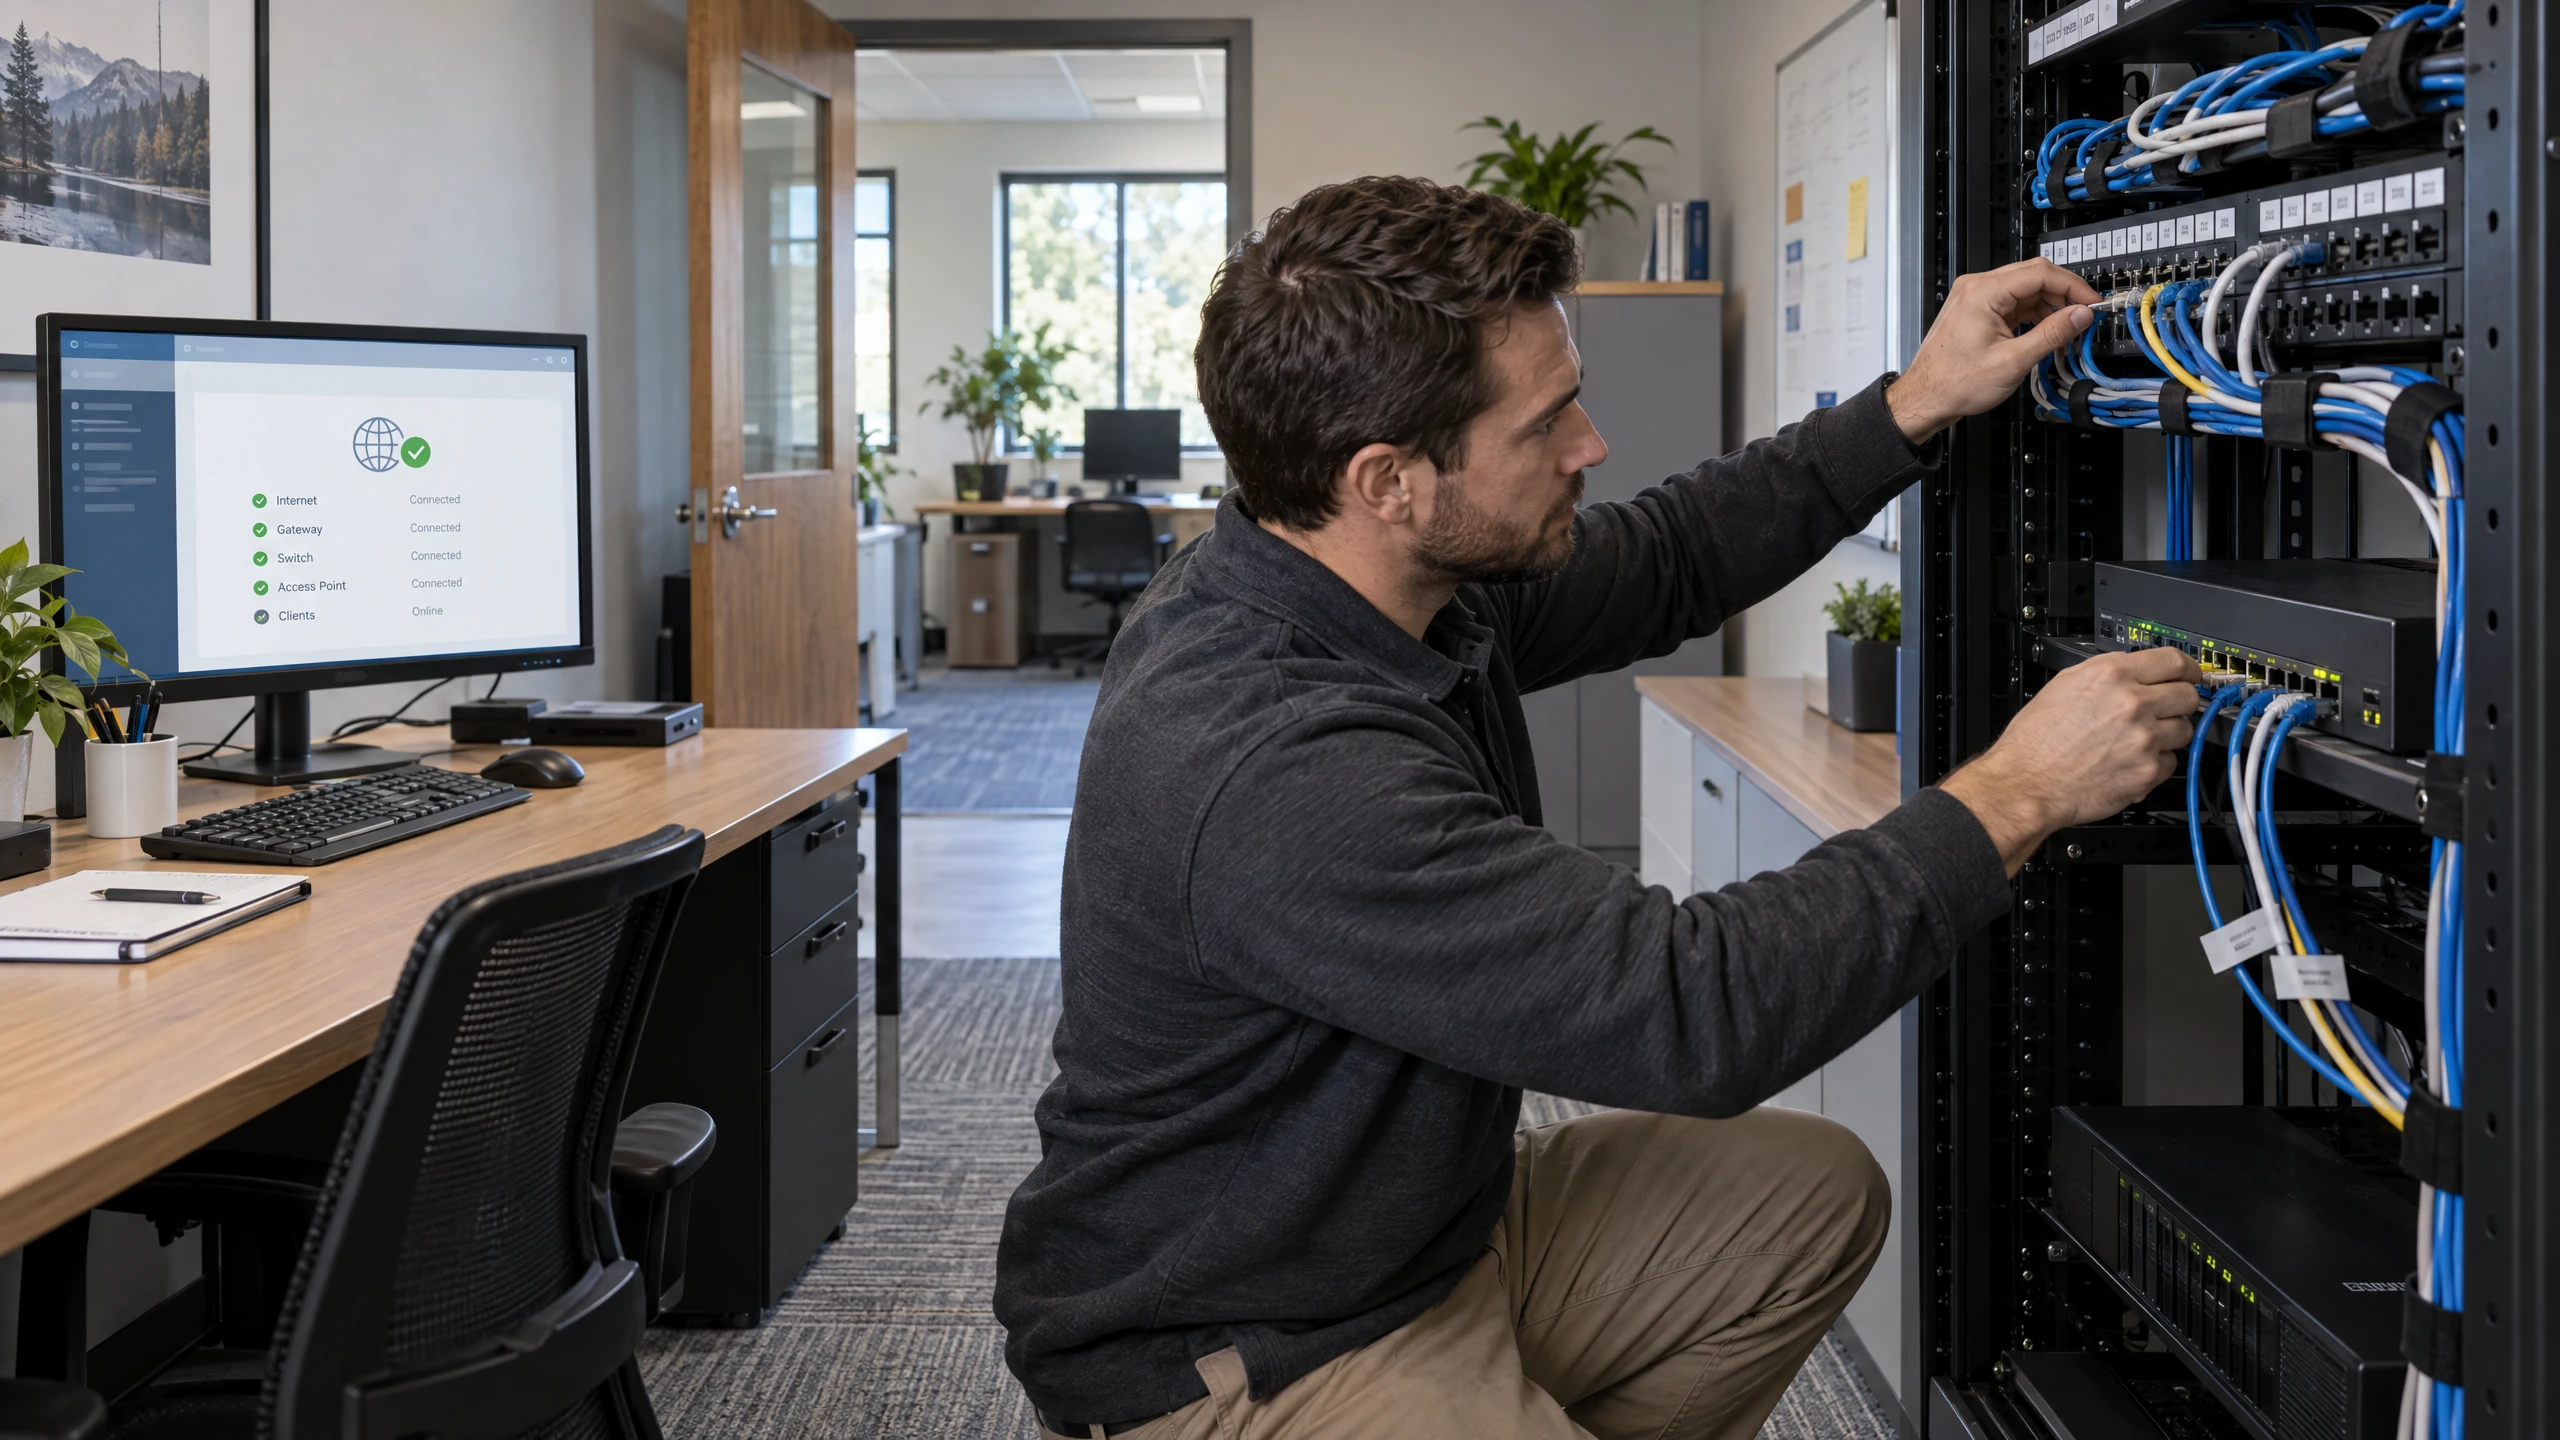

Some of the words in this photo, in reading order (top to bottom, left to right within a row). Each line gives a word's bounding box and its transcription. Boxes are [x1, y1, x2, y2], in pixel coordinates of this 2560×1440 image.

[276, 495, 318, 506] Internet
[409, 494, 461, 505] Connected
[276, 524, 323, 537] Gateway
[410, 522, 461, 533] Connected
[277, 552, 314, 564] Switch
[410, 550, 462, 561] Connected
[277, 581, 317, 593] Access
[319, 580, 347, 591] Point
[411, 577, 463, 589] Connected
[278, 610, 316, 622] Clients
[412, 605, 444, 617] Online
